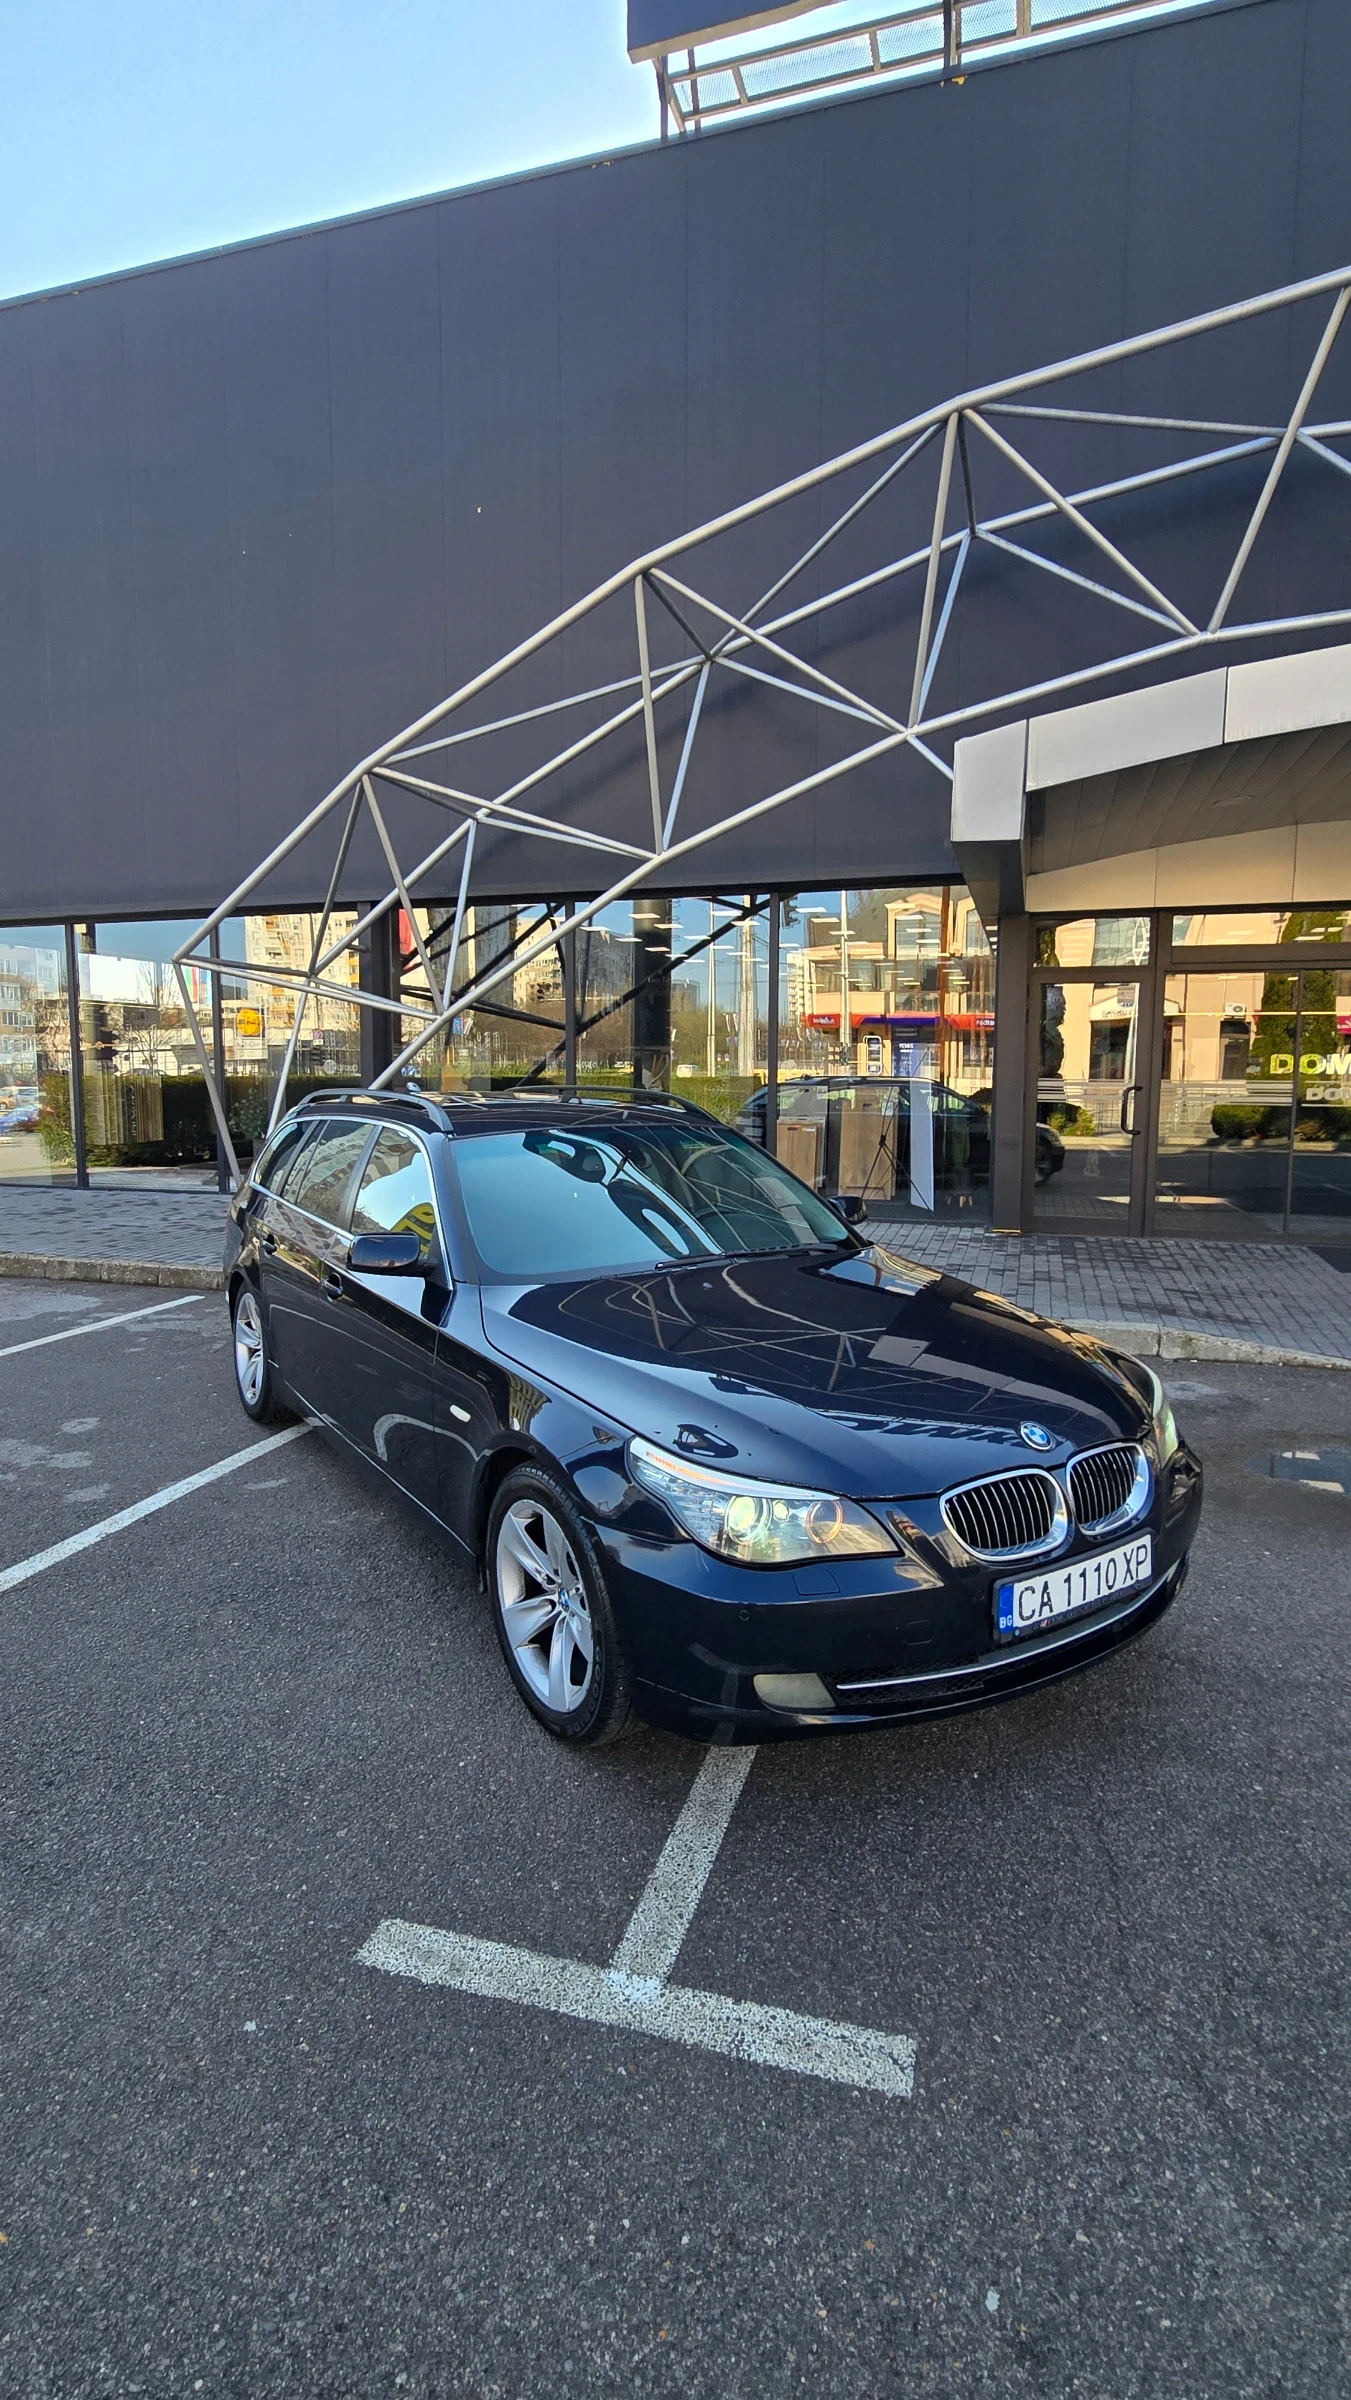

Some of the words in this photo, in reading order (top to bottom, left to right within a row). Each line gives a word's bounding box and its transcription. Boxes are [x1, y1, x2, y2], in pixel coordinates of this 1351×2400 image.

[1018, 1580, 1054, 1622] CA
[1063, 1557, 1118, 1607] 1110
[1122, 1543, 1148, 1585] XP
[999, 1614, 1013, 1629] BG
